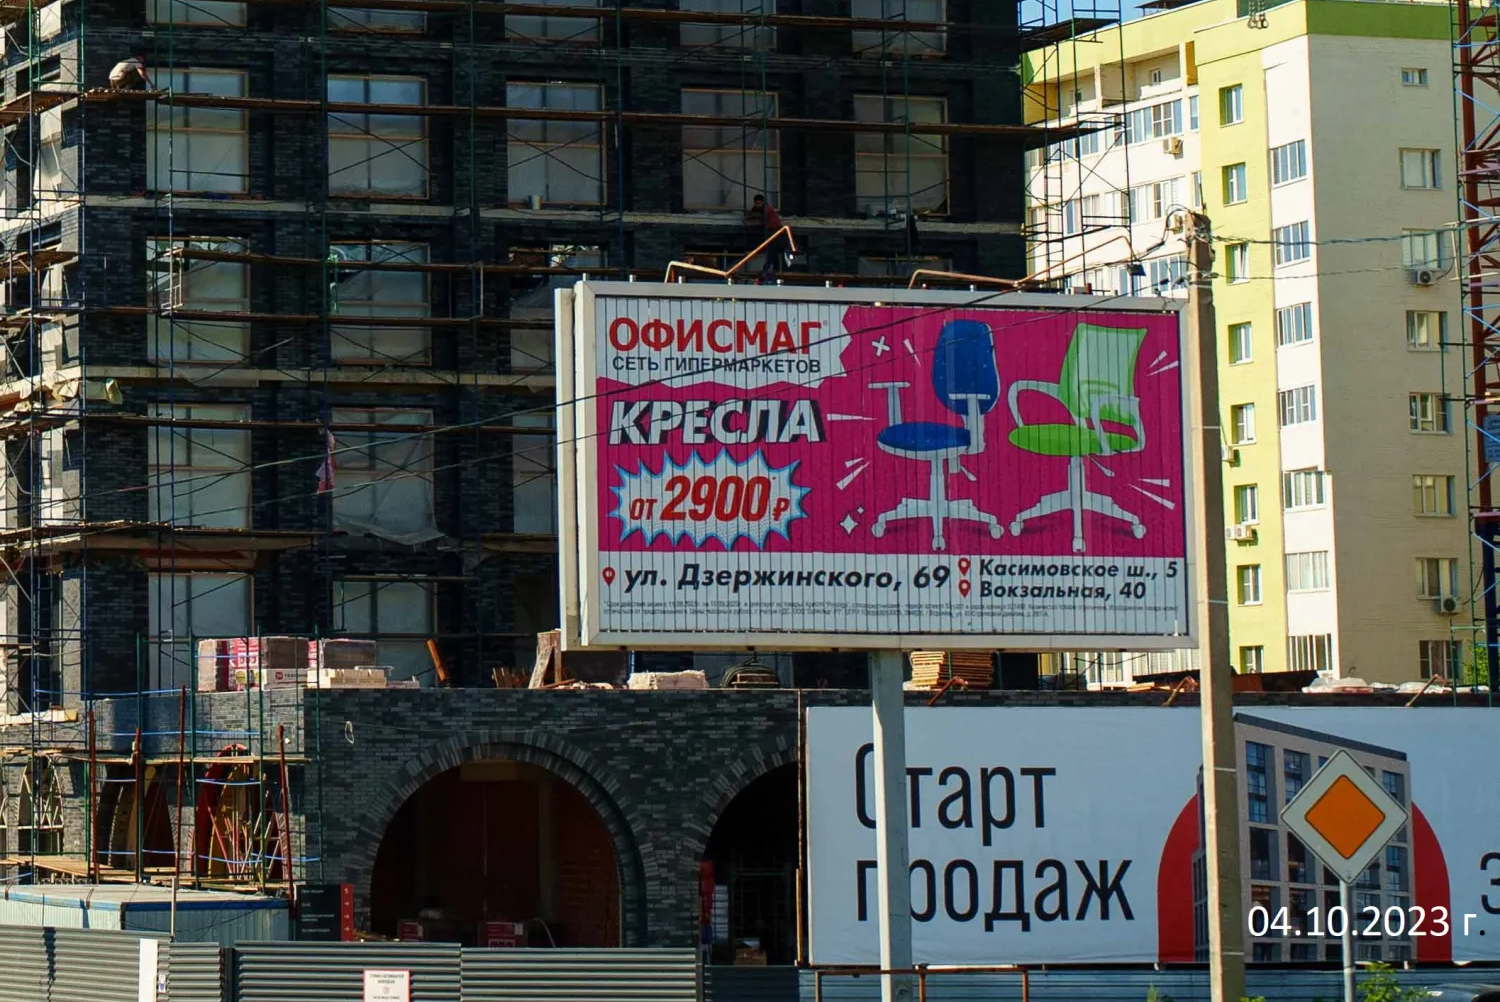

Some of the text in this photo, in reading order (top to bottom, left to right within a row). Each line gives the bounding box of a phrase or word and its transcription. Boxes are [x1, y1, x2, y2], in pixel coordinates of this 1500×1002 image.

[609, 317, 822, 355] ОФИСМАГ
[612, 356, 821, 374] СЕТЬ ГИПЕРМАРКЕТОВ
[609, 399, 824, 445] КРЕСЛА
[624, 563, 950, 593] ул. Дзержинского, 69
[980, 559, 1178, 580] Касимовское ш., 5
[980, 581, 1146, 601] Вокзальная, 40
